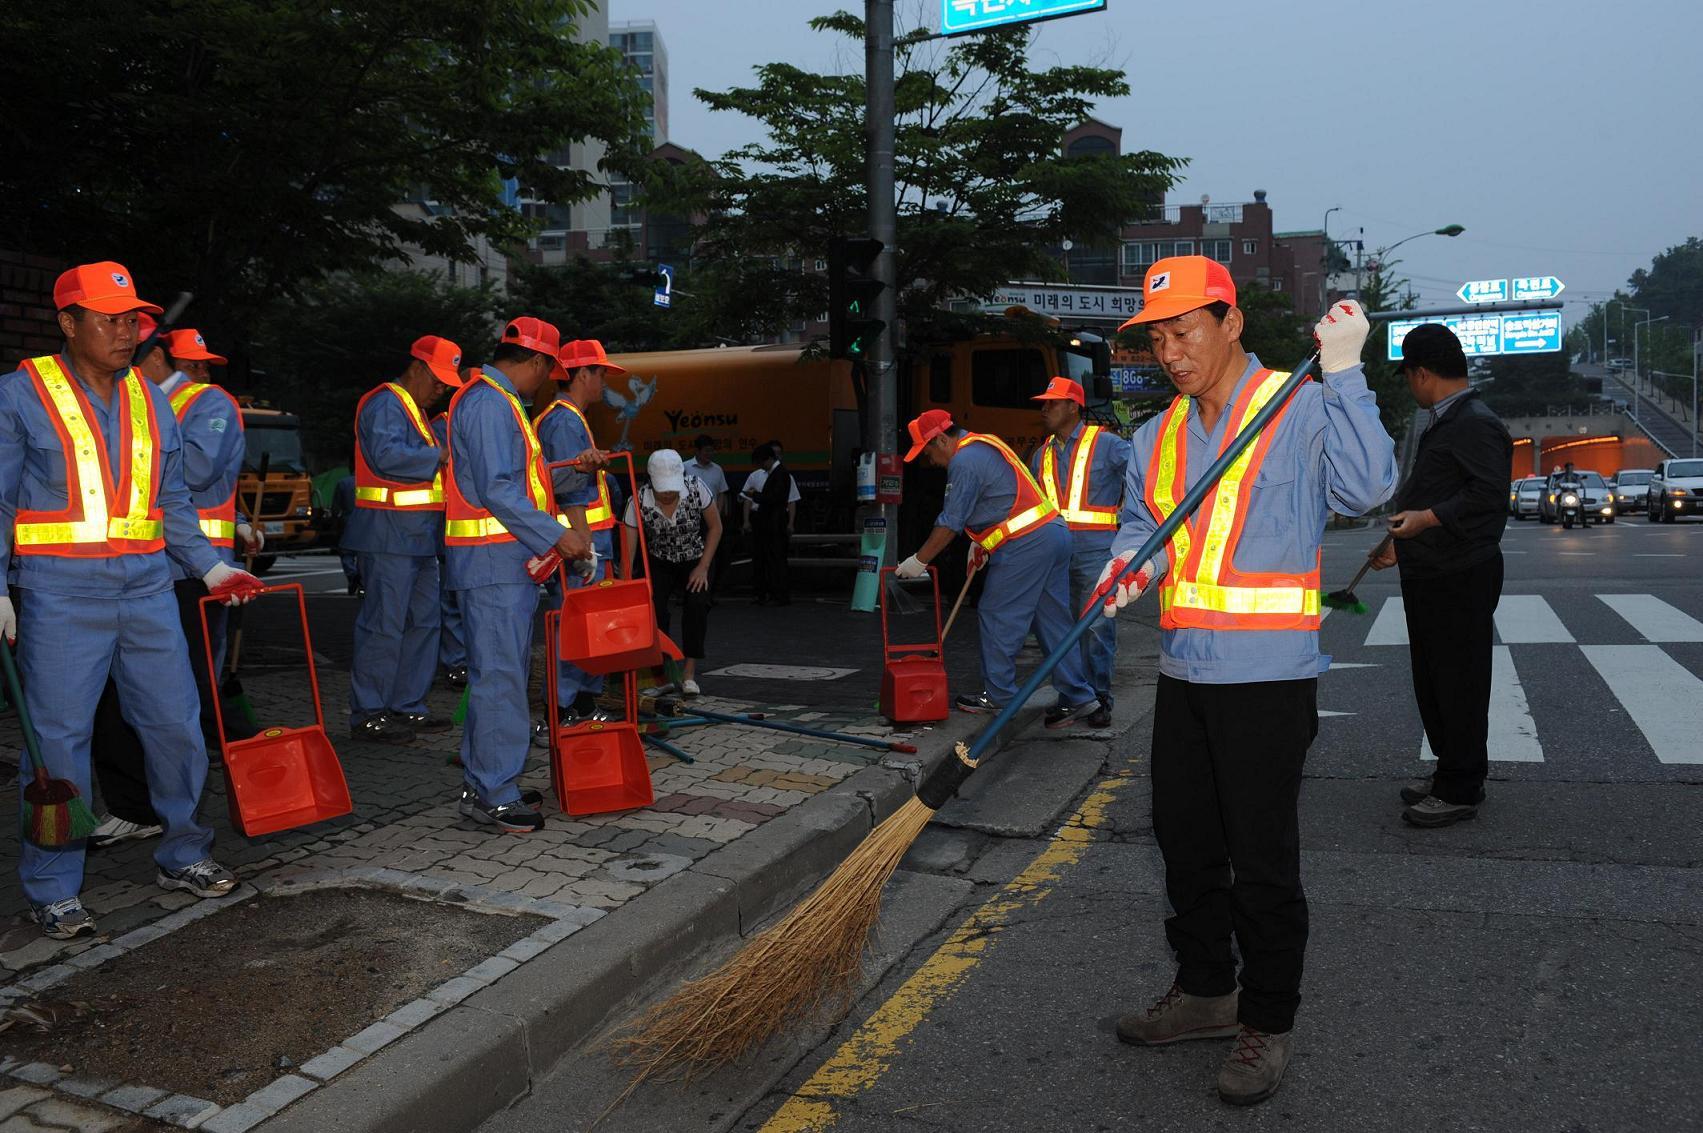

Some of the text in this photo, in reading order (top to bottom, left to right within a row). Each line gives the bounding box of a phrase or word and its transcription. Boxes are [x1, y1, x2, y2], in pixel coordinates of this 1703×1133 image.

[1034, 293, 1073, 310] 미래의
[1079, 295, 1104, 311] 도시
[664, 410, 738, 433] Yeonsu
